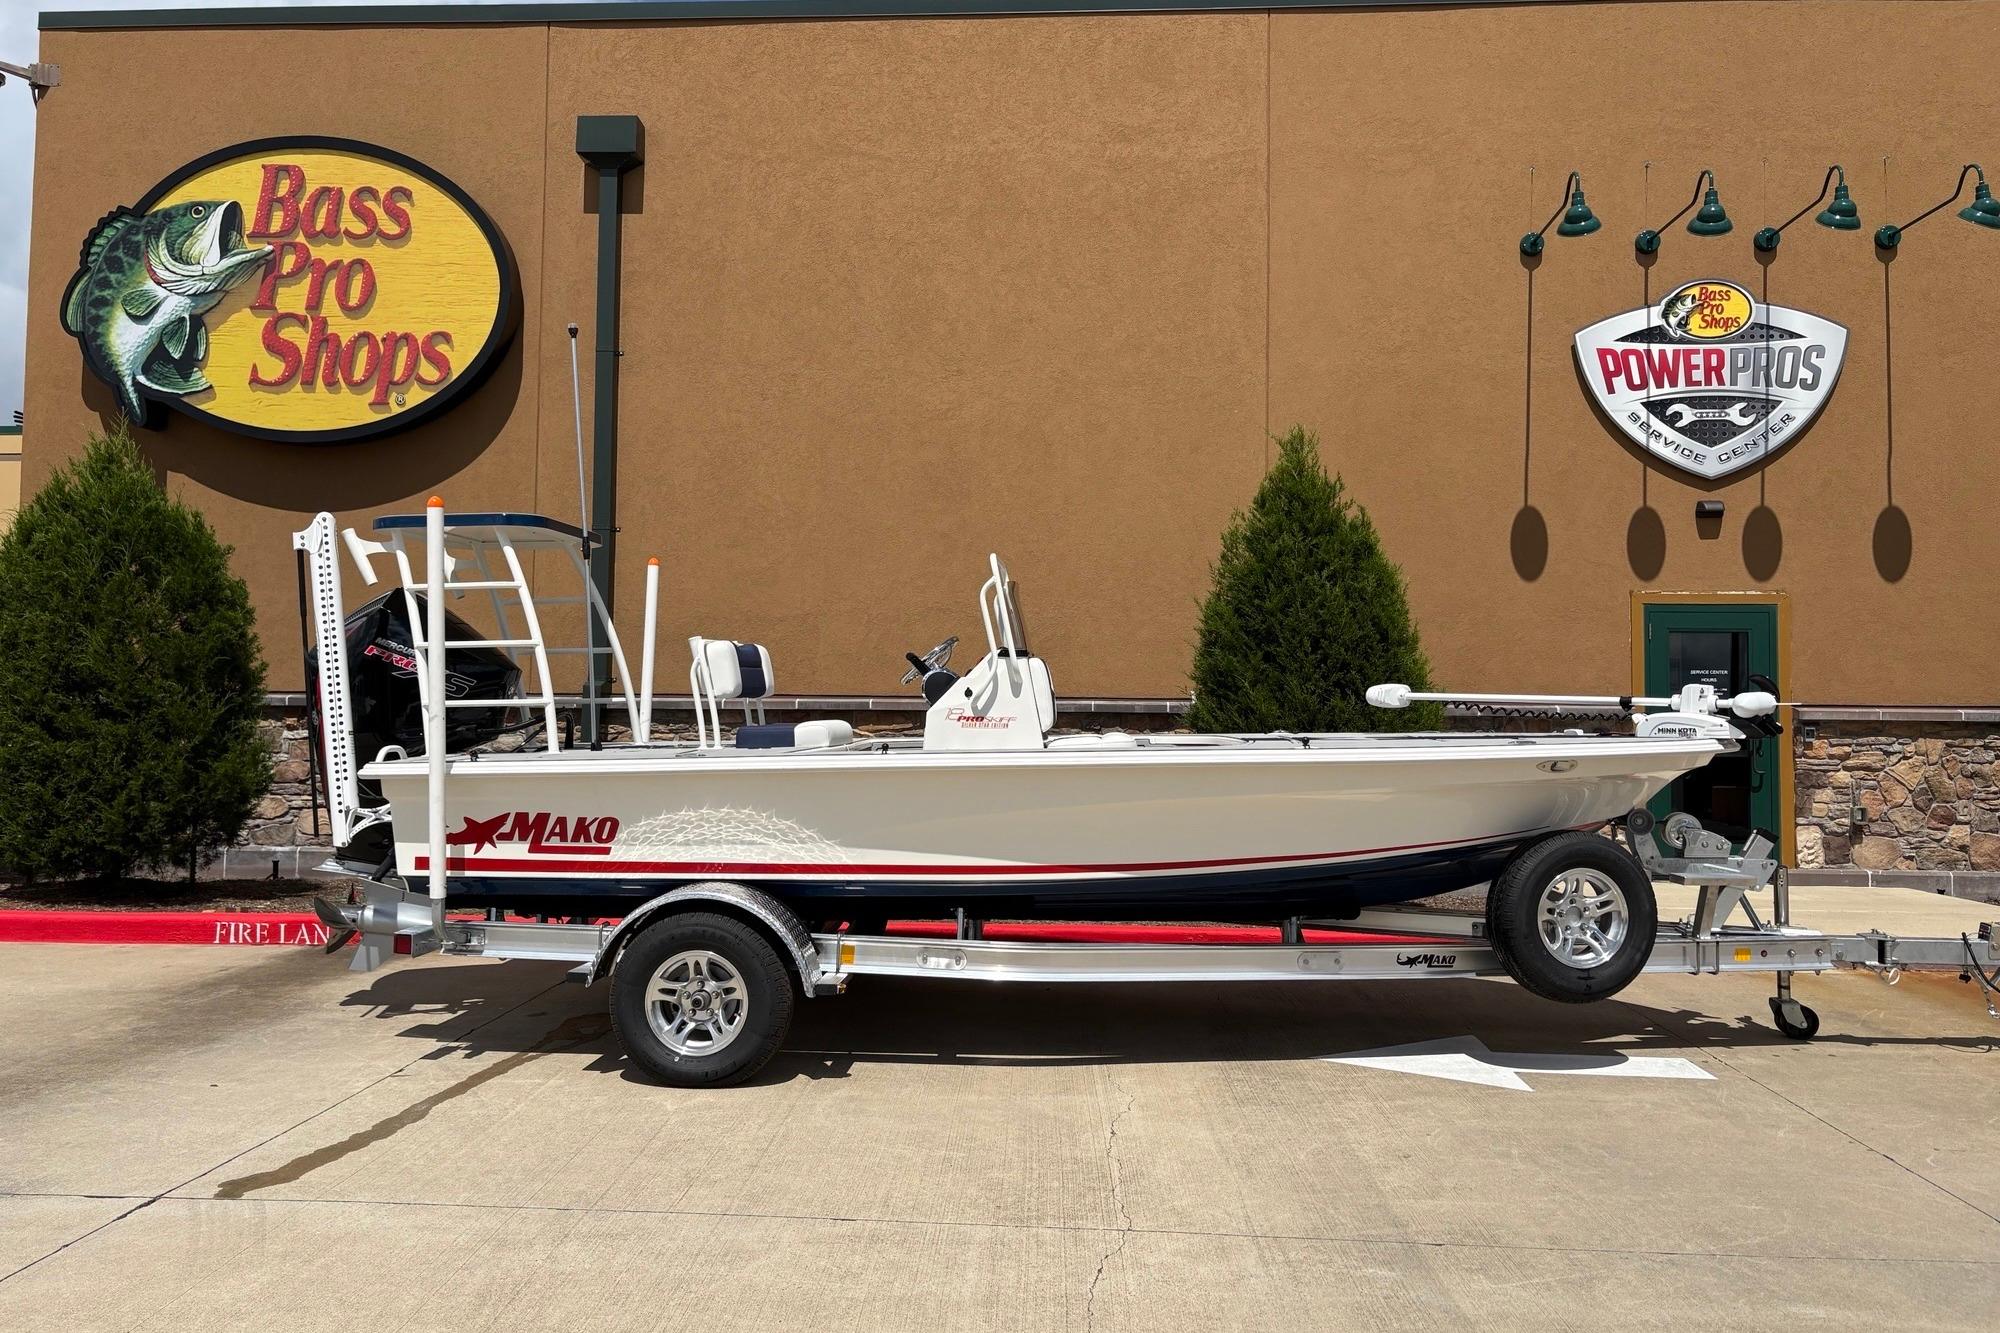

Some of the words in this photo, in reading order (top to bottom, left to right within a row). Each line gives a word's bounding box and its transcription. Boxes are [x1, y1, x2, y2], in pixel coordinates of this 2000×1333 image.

[246, 163, 413, 241] Bass
[248, 241, 377, 312] Pro
[1697, 286, 1731, 302] Bass
[1698, 301, 1725, 315] Pro
[1699, 314, 1741, 332] Shops
[248, 312, 453, 406] Shops
[1627, 411, 1707, 465] SERVICE
[1717, 412, 1796, 464] CENTER
[375, 638, 417, 656] MERCUR
[496, 811, 620, 855] MAKO
[213, 921, 270, 944] FIRE
[278, 922, 330, 945] LAN
[1418, 954, 1457, 968] MAKO
